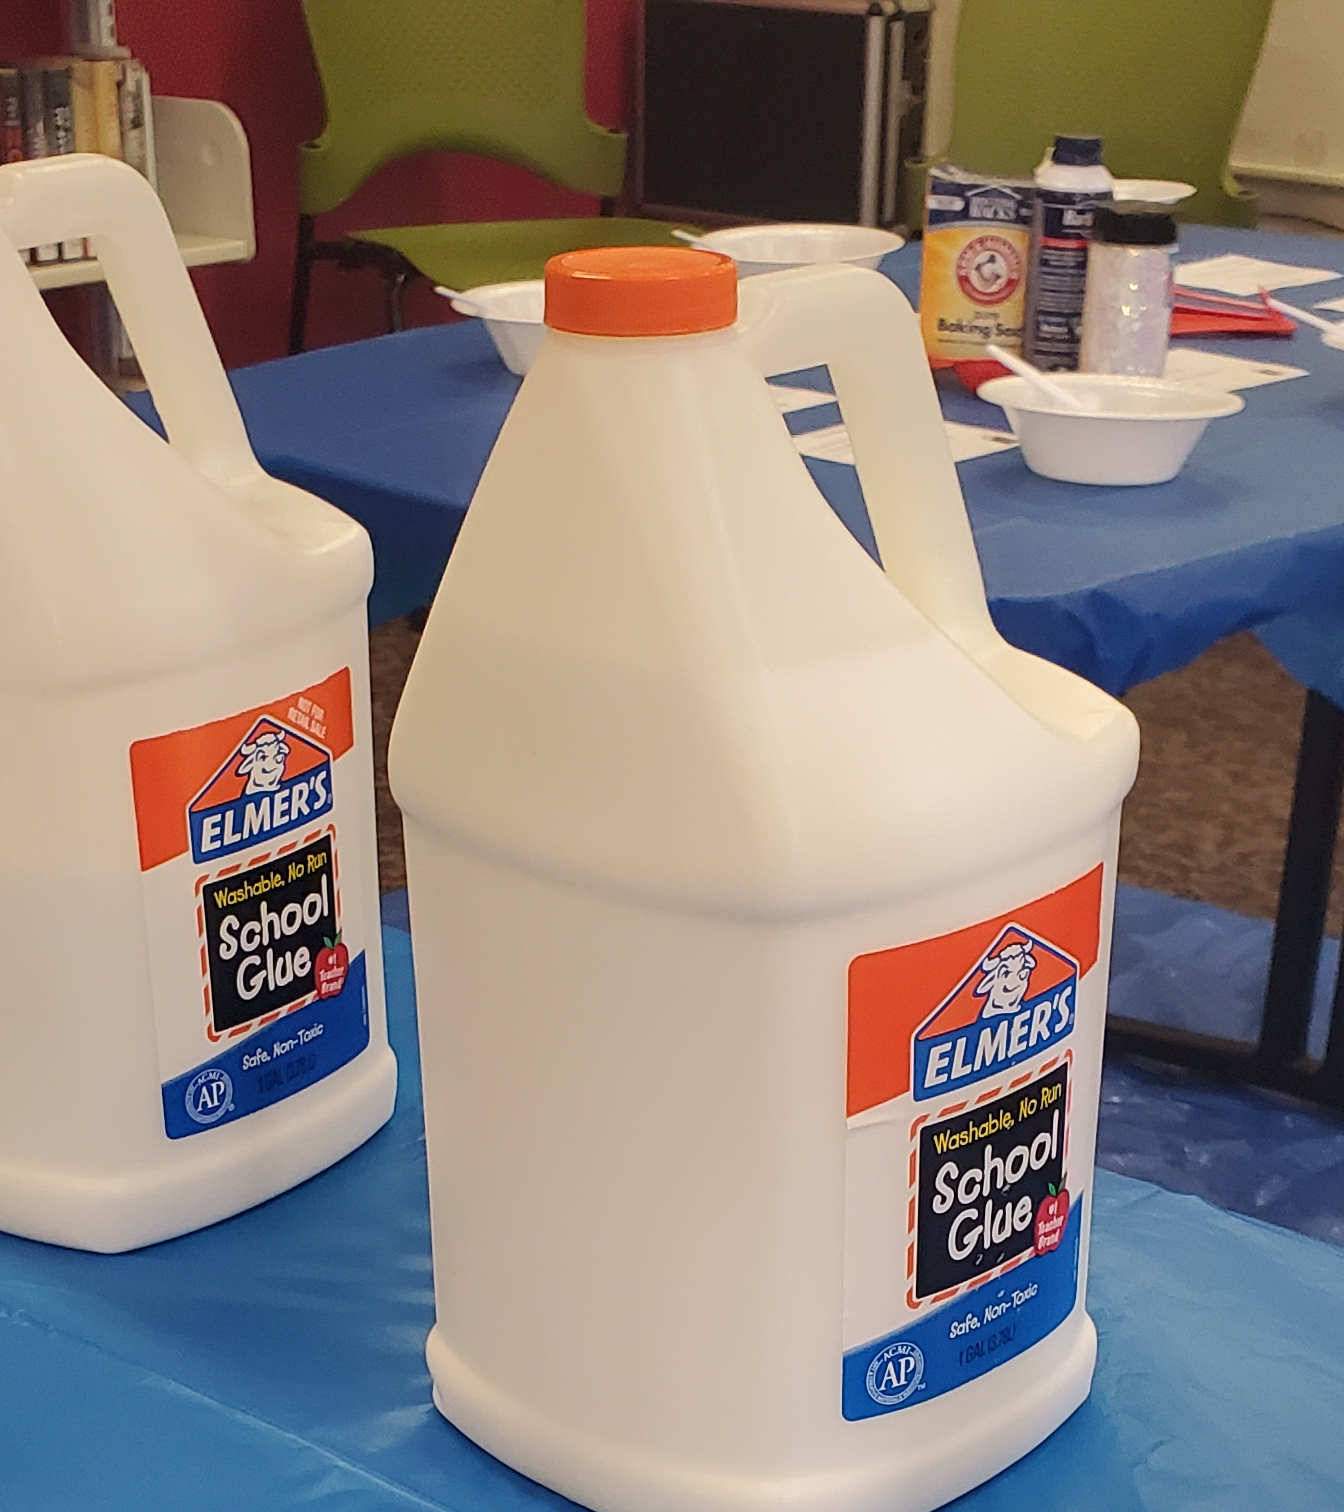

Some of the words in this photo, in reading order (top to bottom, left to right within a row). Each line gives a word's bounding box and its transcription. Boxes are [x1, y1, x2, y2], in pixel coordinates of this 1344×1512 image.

[938, 318, 990, 339] Baking
[201, 770, 328, 853] ELMER'S
[288, 861, 304, 883] No
[307, 852, 327, 874] Run
[219, 873, 329, 960] School
[236, 946, 312, 1000] Glue
[272, 1023, 324, 1059] Non-Toxic
[924, 985, 1073, 1088] ELMER'S
[197, 1081, 225, 1112] AP
[1018, 1097, 1037, 1122] No
[1040, 1083, 1062, 1110] Run
[932, 1109, 1059, 1214] School
[948, 1196, 1032, 1261] Glue
[983, 1282, 1038, 1325] Non-Toxic
[878, 1356, 915, 1391] AP
[883, 1345, 912, 1361] ACMI
